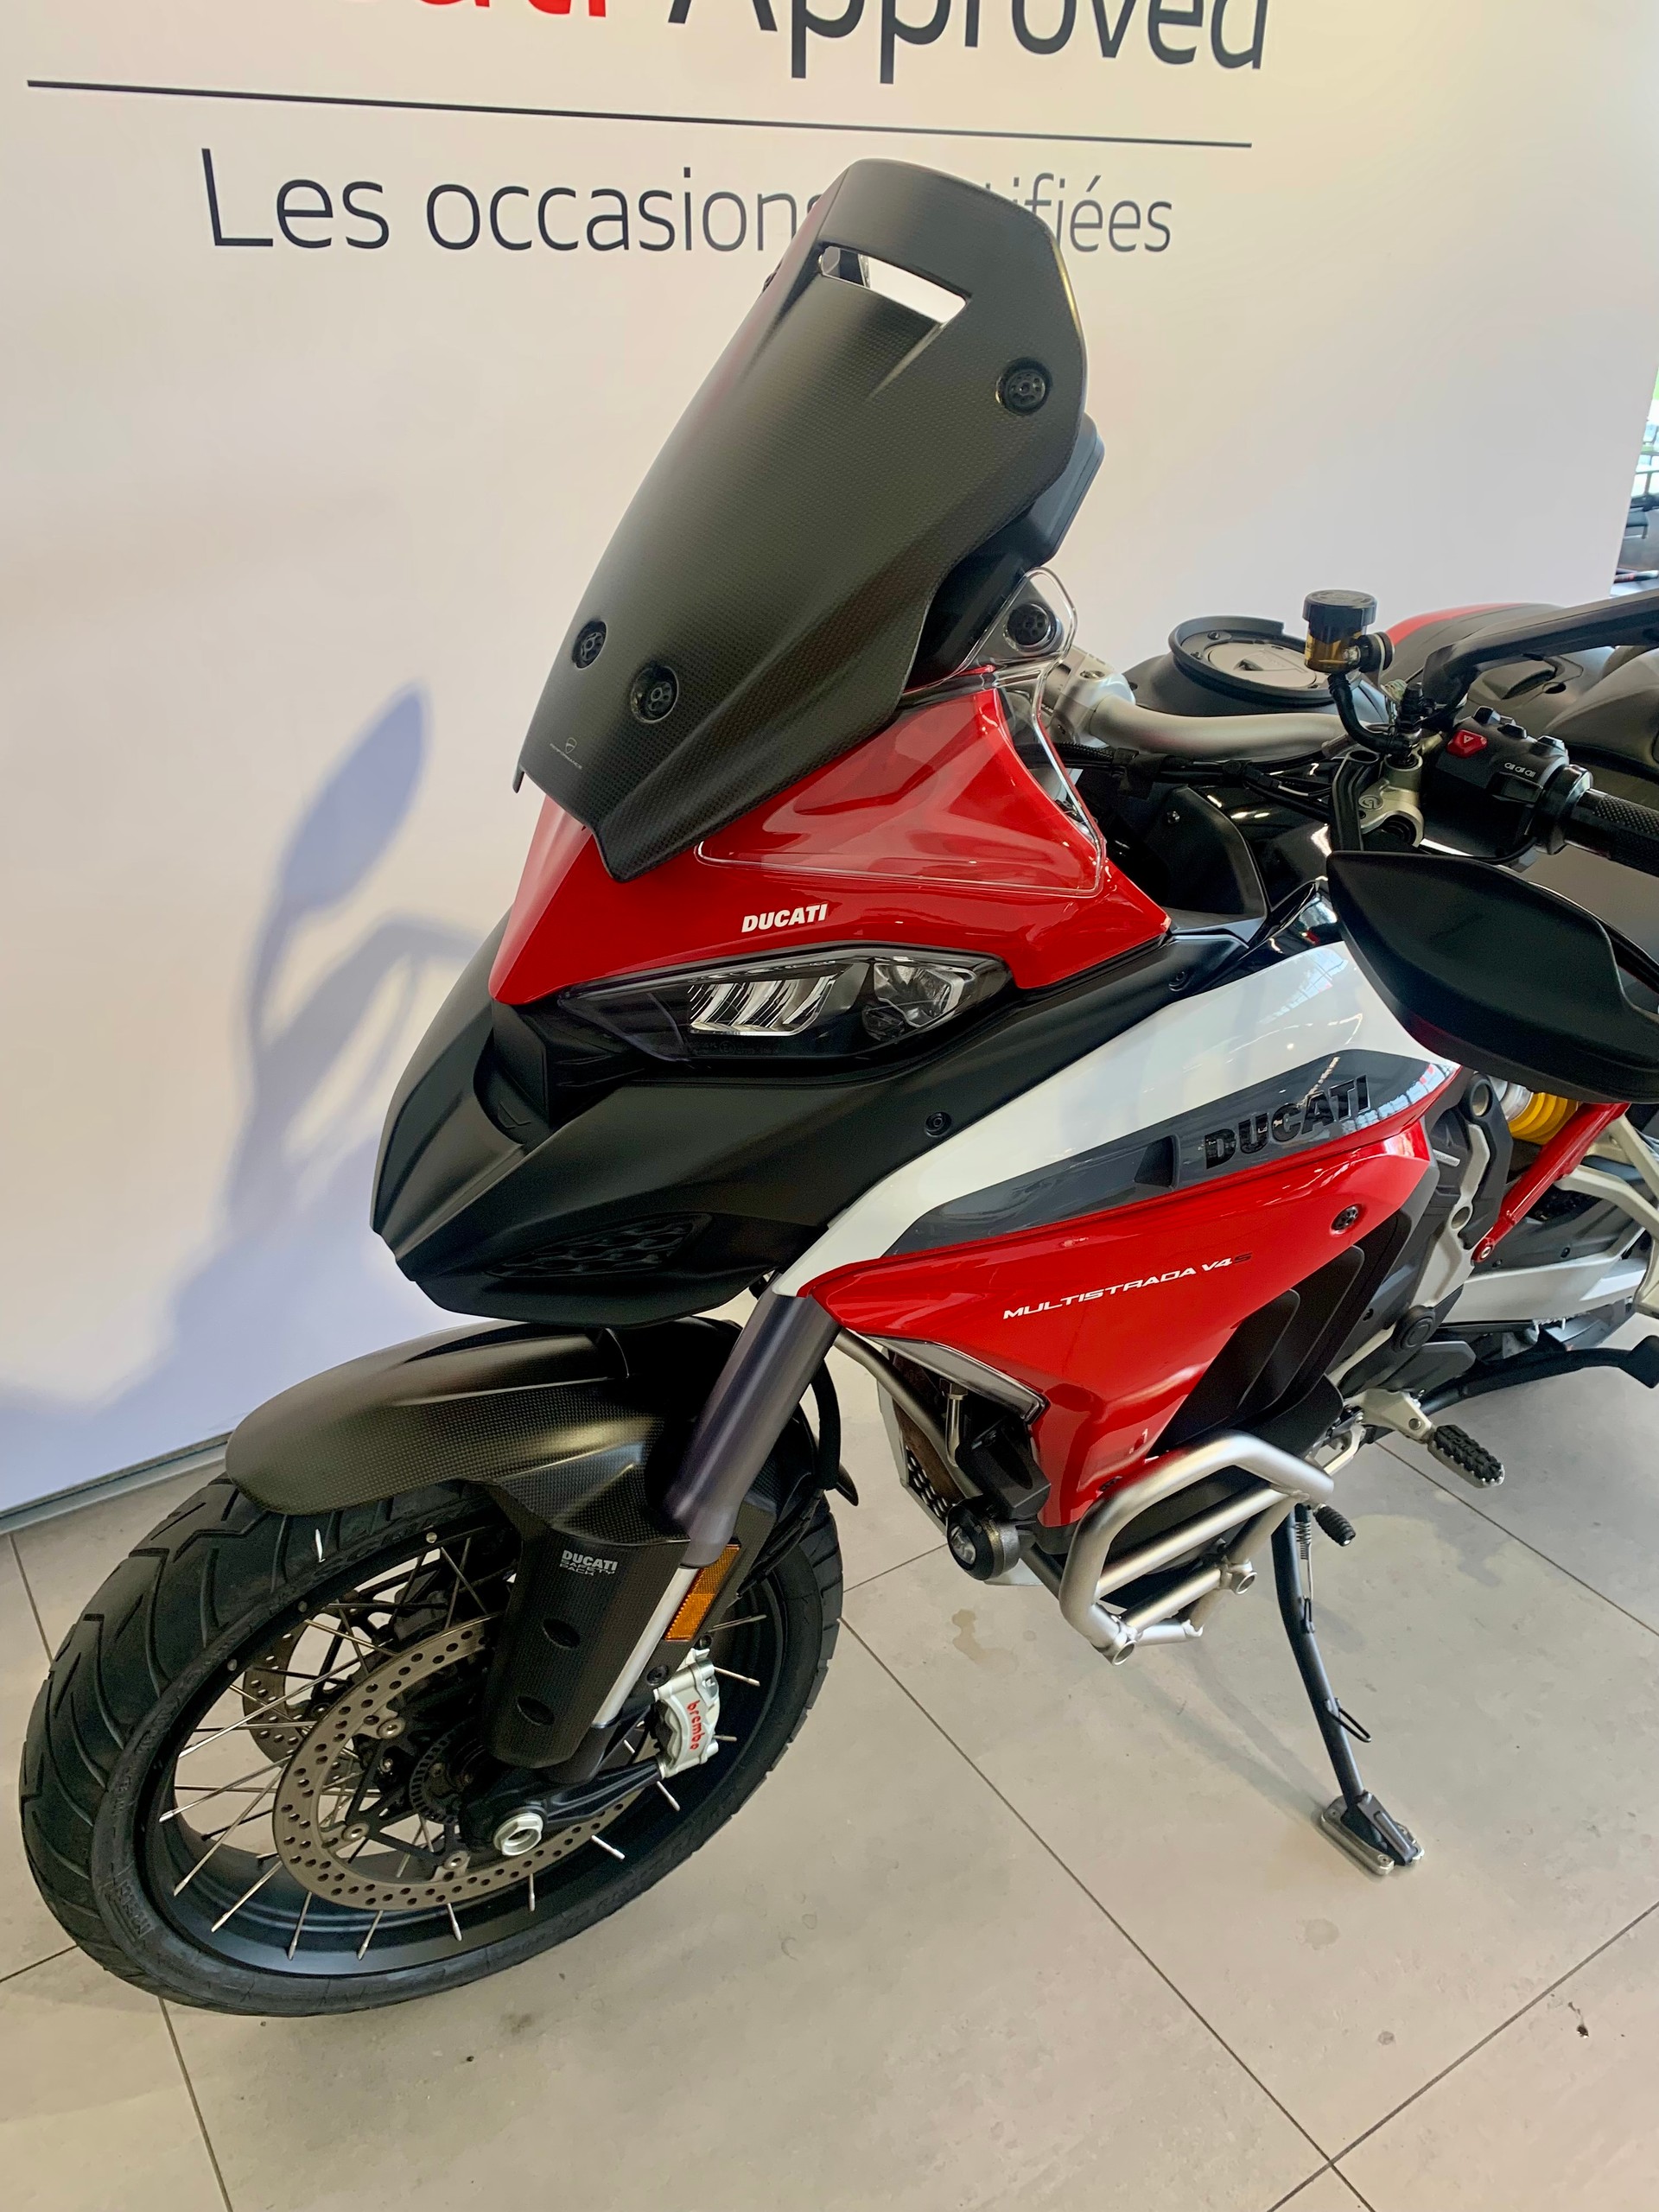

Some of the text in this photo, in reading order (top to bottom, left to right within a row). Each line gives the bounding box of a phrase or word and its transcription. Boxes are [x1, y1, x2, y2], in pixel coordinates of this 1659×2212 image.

[201, 148, 391, 249] Les
[426, 167, 821, 251] occasion
[741, 904, 828, 932] DUCATI
[1204, 1075, 1370, 1169] DUCATI
[1002, 1268, 1196, 1319] MULTISTRADA
[562, 1549, 619, 1571] DUCATI
[687, 1700, 705, 1750] brembo
